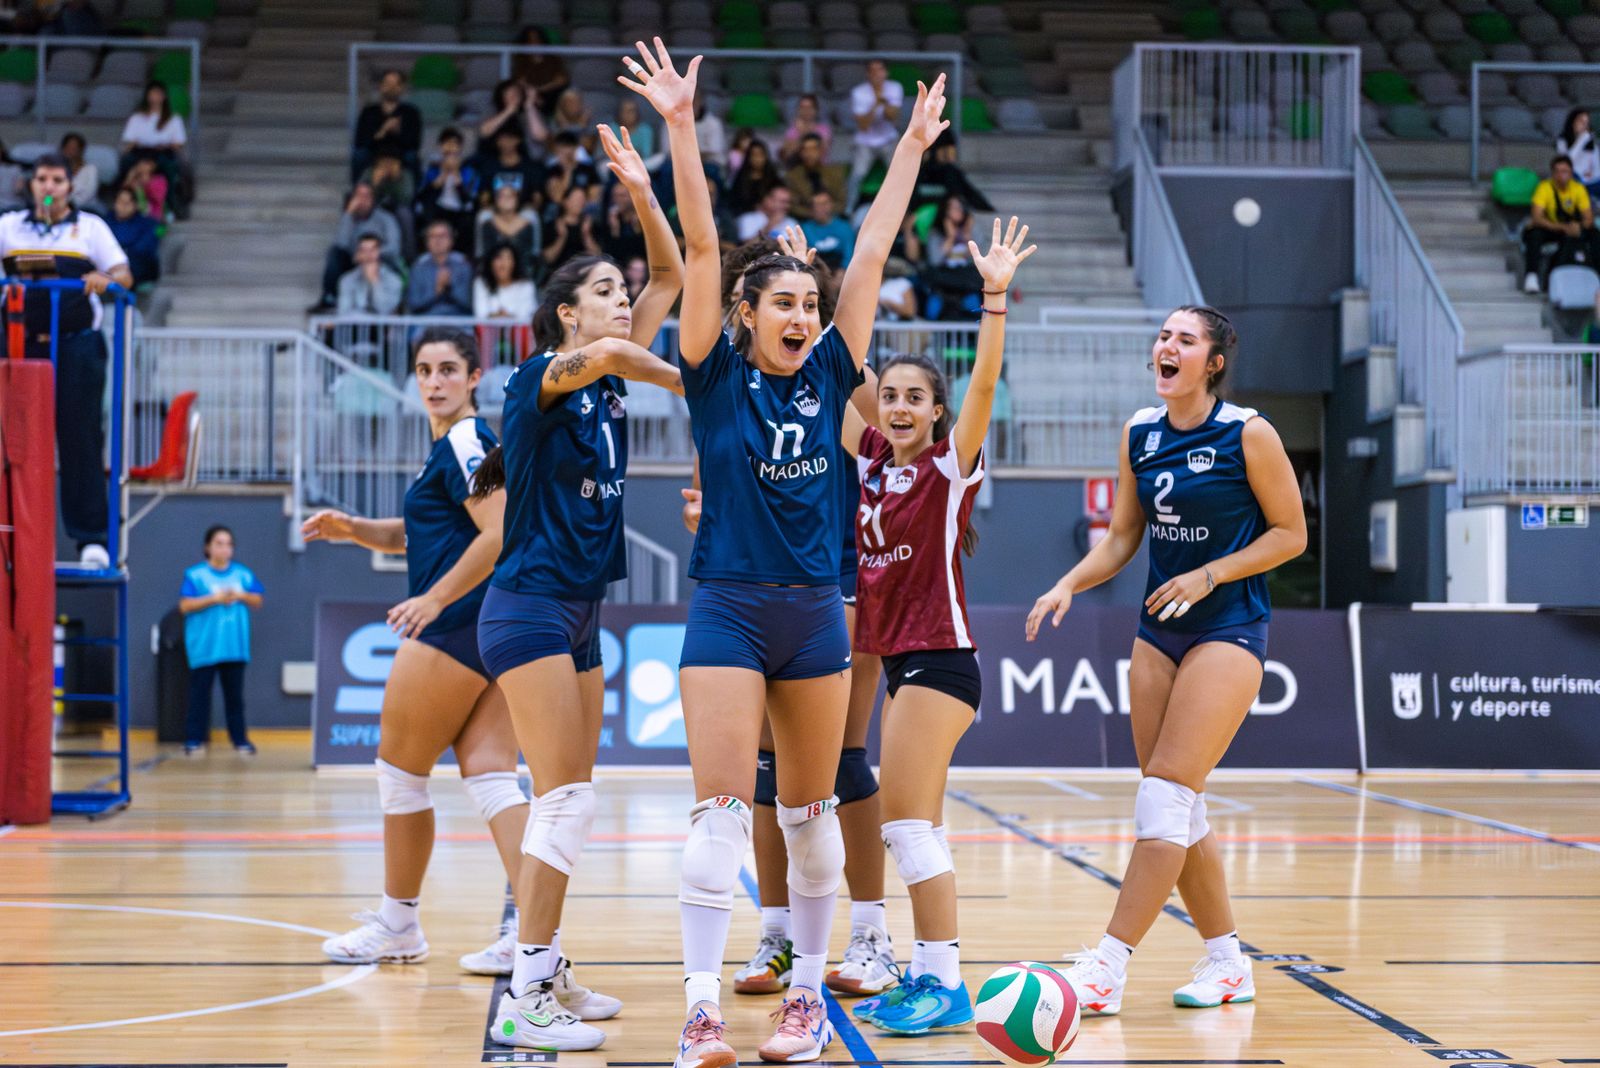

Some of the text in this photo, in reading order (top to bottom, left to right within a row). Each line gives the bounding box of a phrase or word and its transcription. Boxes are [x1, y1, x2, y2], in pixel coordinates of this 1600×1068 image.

[602, 422, 616, 469] 1
[766, 419, 805, 460] 17
[760, 457, 828, 480] MADRID
[1154, 471, 1175, 514] 2
[1151, 524, 1209, 542] MADRID
[1450, 671, 1528, 694] cultura,
[1451, 695, 1551, 722] y deporte
